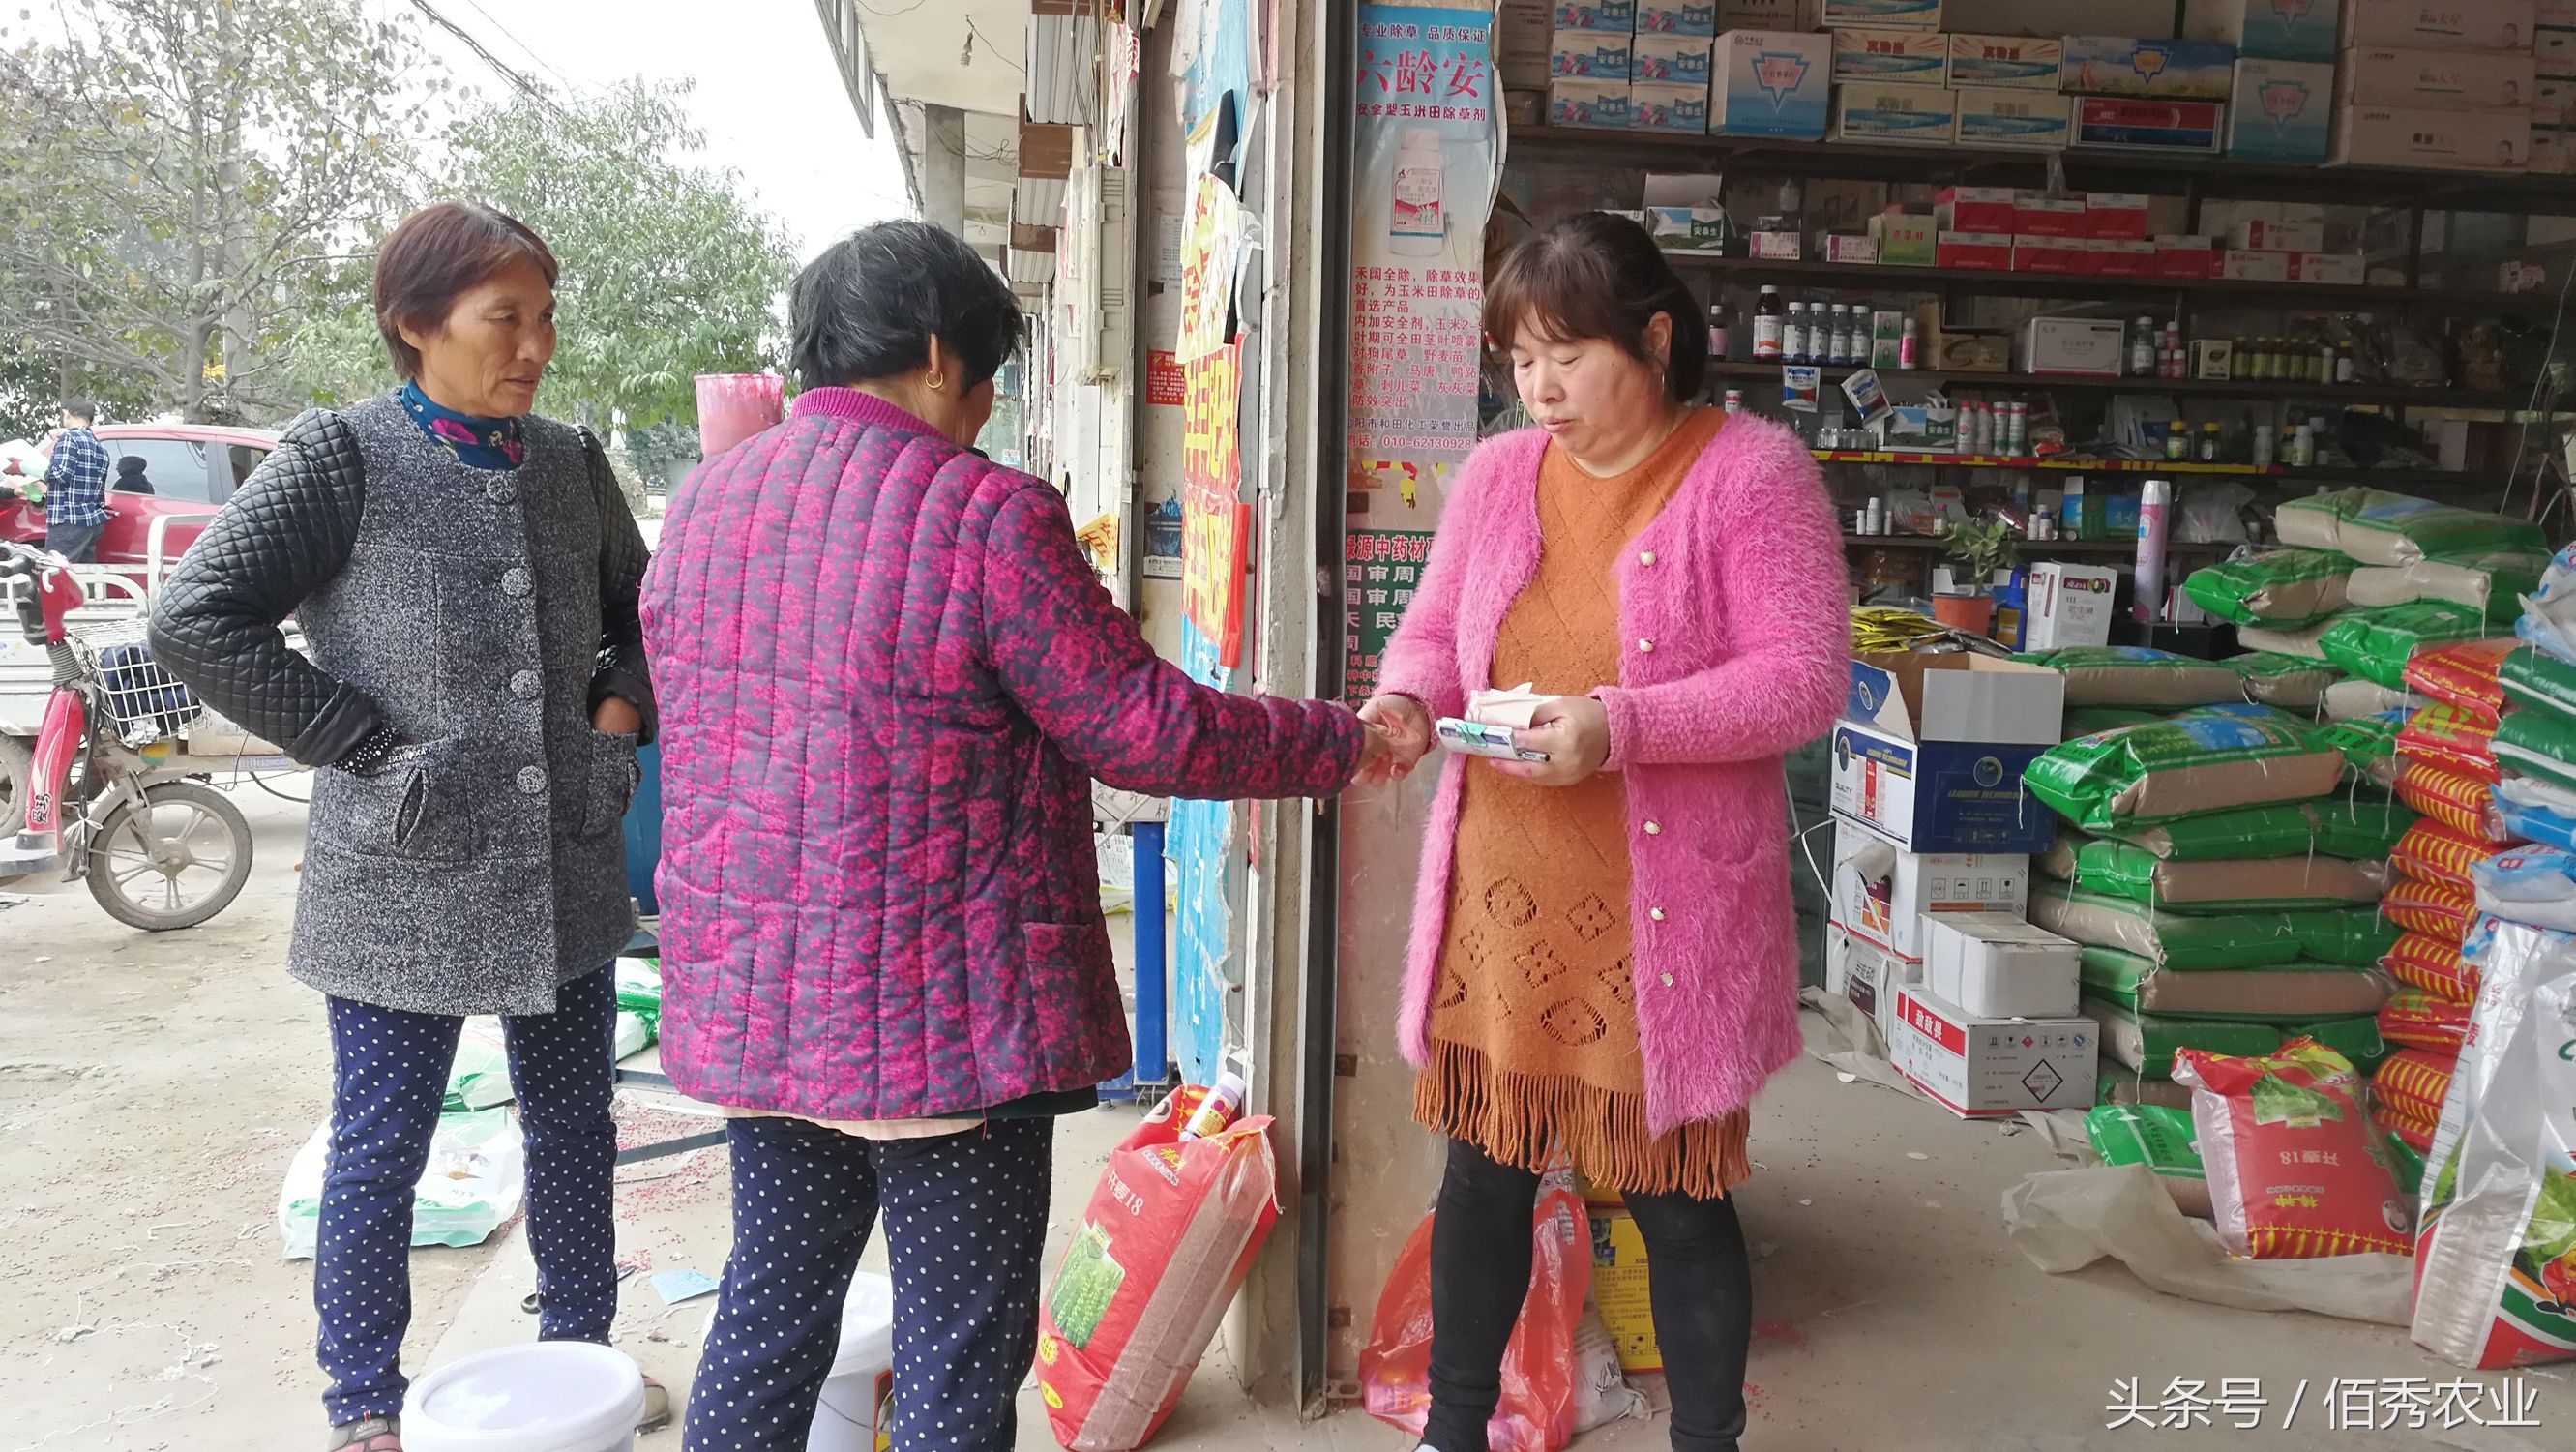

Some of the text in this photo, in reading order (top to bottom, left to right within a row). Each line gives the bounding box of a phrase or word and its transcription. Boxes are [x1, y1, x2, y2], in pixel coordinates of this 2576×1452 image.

[1360, 23, 1486, 43] 专业除草 品质保证
[1357, 49, 1485, 98] 六龄安
[1356, 102, 1486, 122] 安全型玉米田除草剂
[1355, 282, 1480, 300] 好，为玉米田除草的
[1347, 565, 1425, 583] 国审周
[1915, 1009, 1943, 1041] 敌敌畏
[1106, 1171, 1143, 1217] 开麦18
